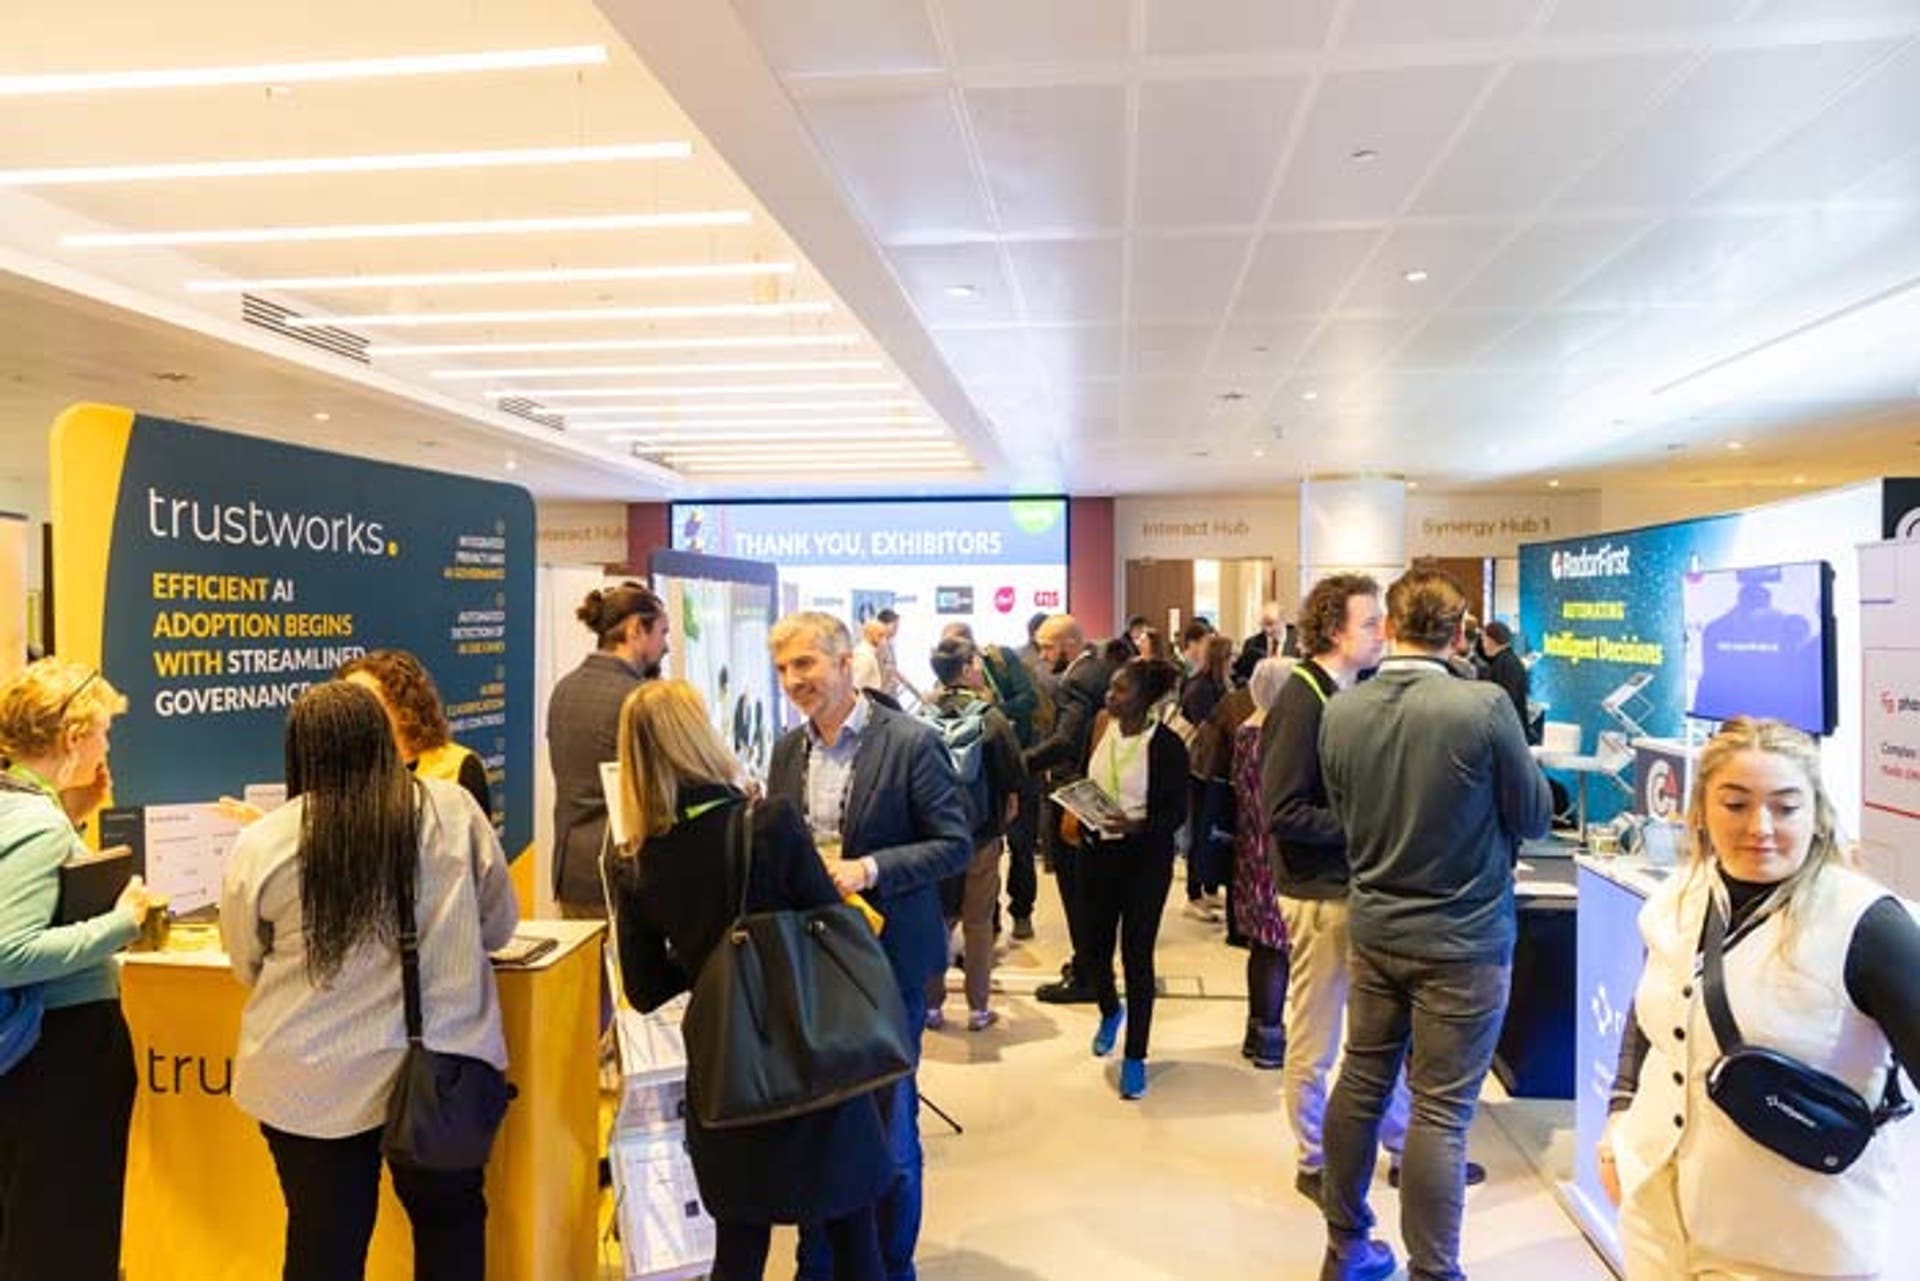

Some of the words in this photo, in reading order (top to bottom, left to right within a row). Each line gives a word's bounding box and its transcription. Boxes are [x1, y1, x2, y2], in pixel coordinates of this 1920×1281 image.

[148, 487, 398, 556] trustworks.
[1213, 518, 1249, 536] Hub
[1500, 517, 1537, 534] Hub
[734, 531, 809, 555] THANK
[811, 531, 866, 558] YOU,
[871, 530, 1002, 555] EXHIBITORS
[153, 572, 269, 601] EFFICIENT
[271, 578, 295, 602] AI
[153, 612, 280, 638] ADOPTION
[284, 614, 353, 637] BEGINS
[153, 650, 224, 678] WITH
